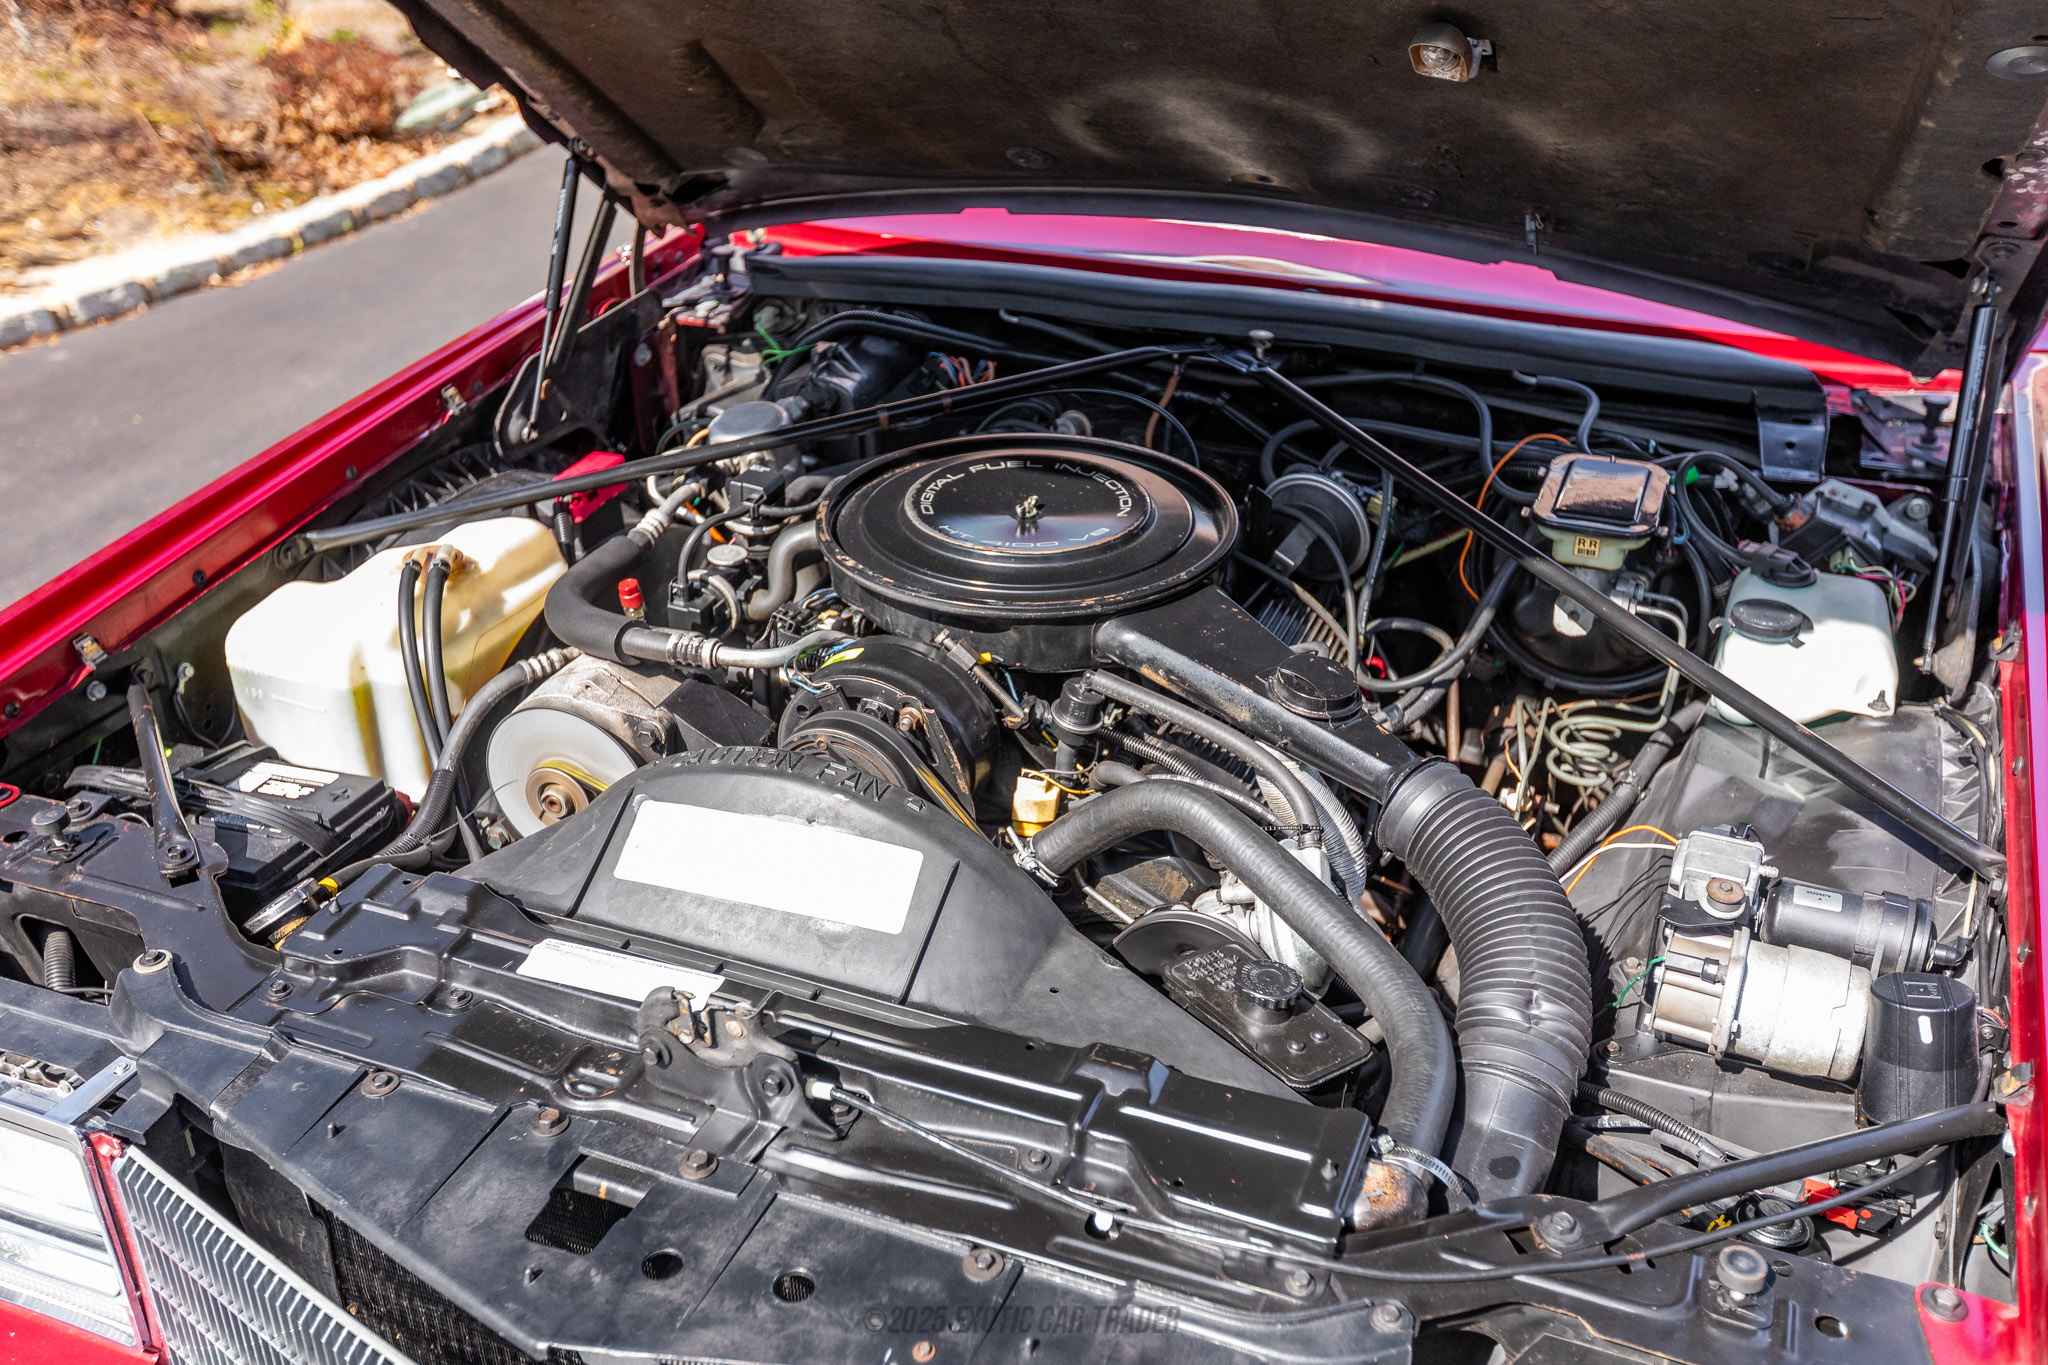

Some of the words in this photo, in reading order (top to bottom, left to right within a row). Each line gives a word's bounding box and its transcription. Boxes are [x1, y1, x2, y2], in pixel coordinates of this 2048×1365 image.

[920, 473, 965, 514] DIGITAL
[969, 460, 1043, 473] FUEL
[1054, 462, 1132, 517] INJECTION
[939, 525, 975, 539] HT
[980, 540, 1059, 548] 4100
[1067, 527, 1110, 541] V8
[670, 745, 806, 773] CAUTION
[815, 761, 892, 803] FAN
